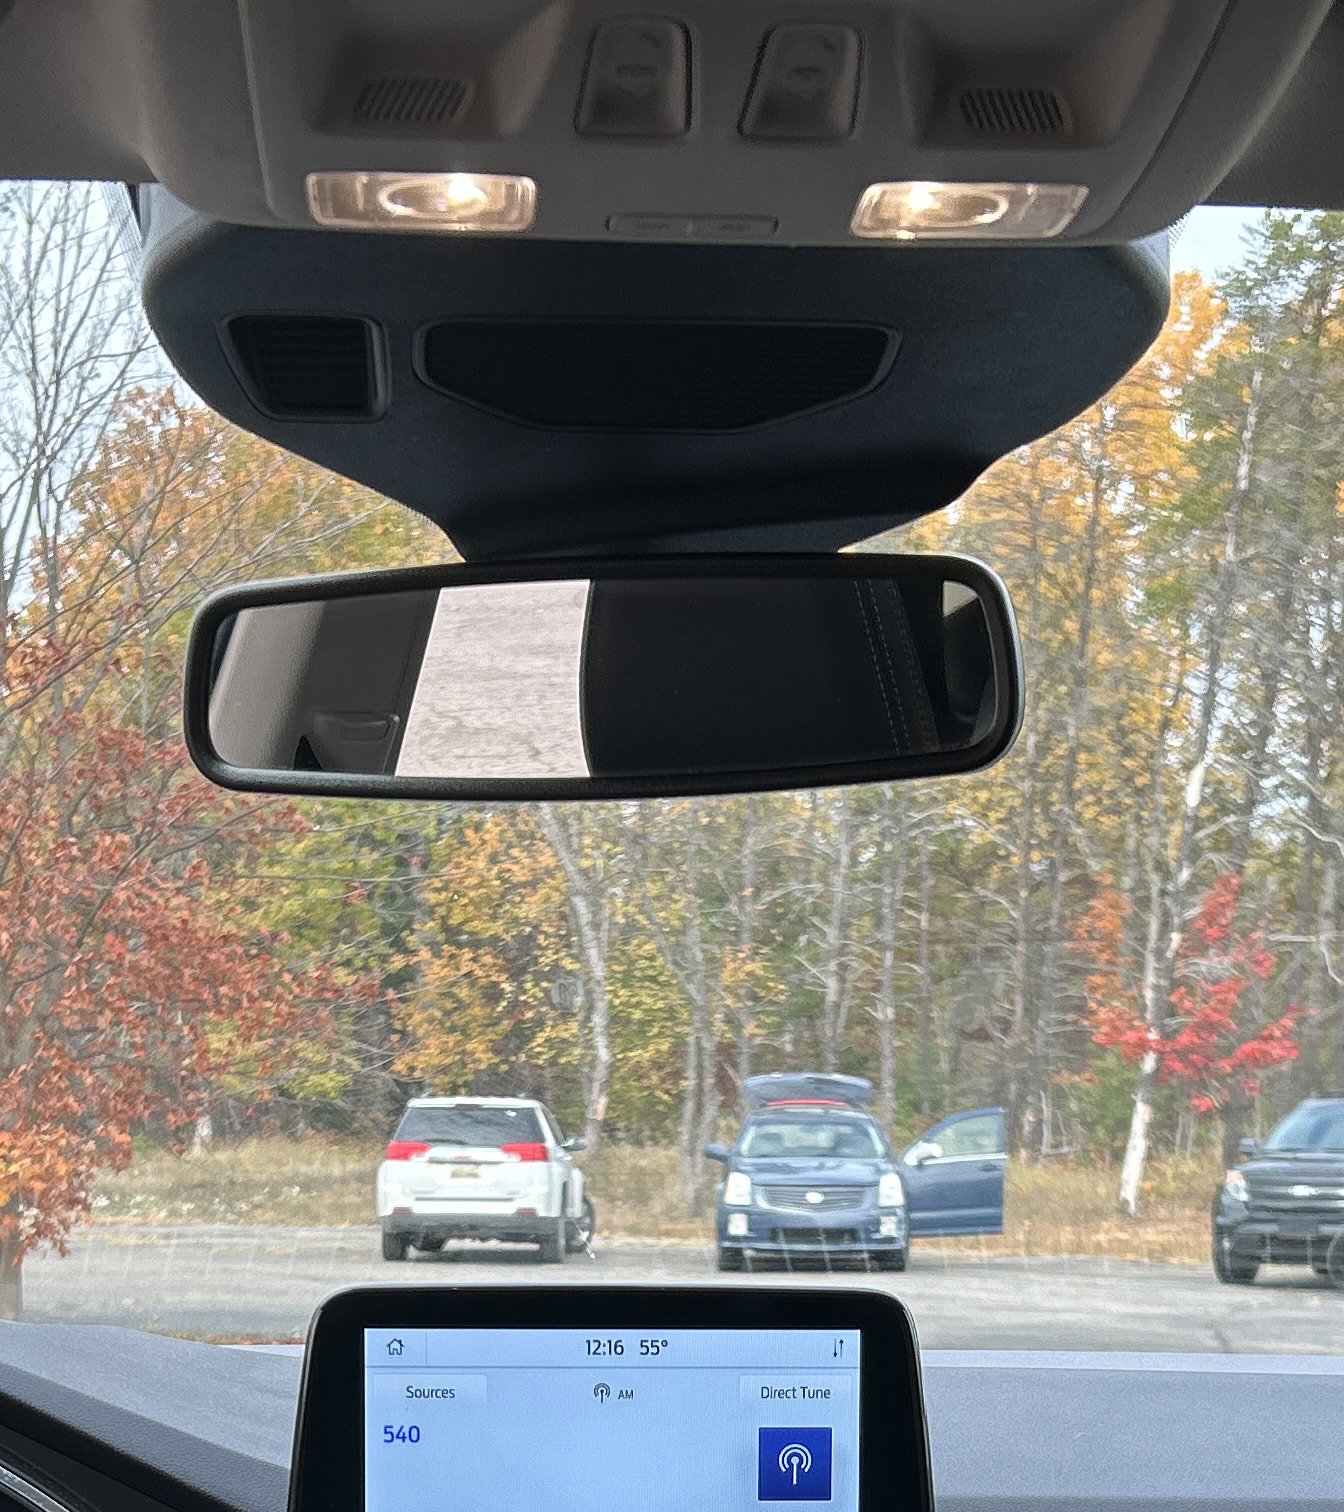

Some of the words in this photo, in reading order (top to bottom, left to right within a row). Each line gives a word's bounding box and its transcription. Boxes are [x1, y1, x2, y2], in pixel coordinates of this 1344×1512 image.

[586, 1339, 624, 1356] 12:16
[639, 1339, 668, 1356] 55°
[406, 1385, 455, 1400] Sources
[618, 1389, 634, 1400] AM
[760, 1385, 797, 1400] Direct
[801, 1385, 831, 1400] Tune
[383, 1425, 421, 1444] 540
